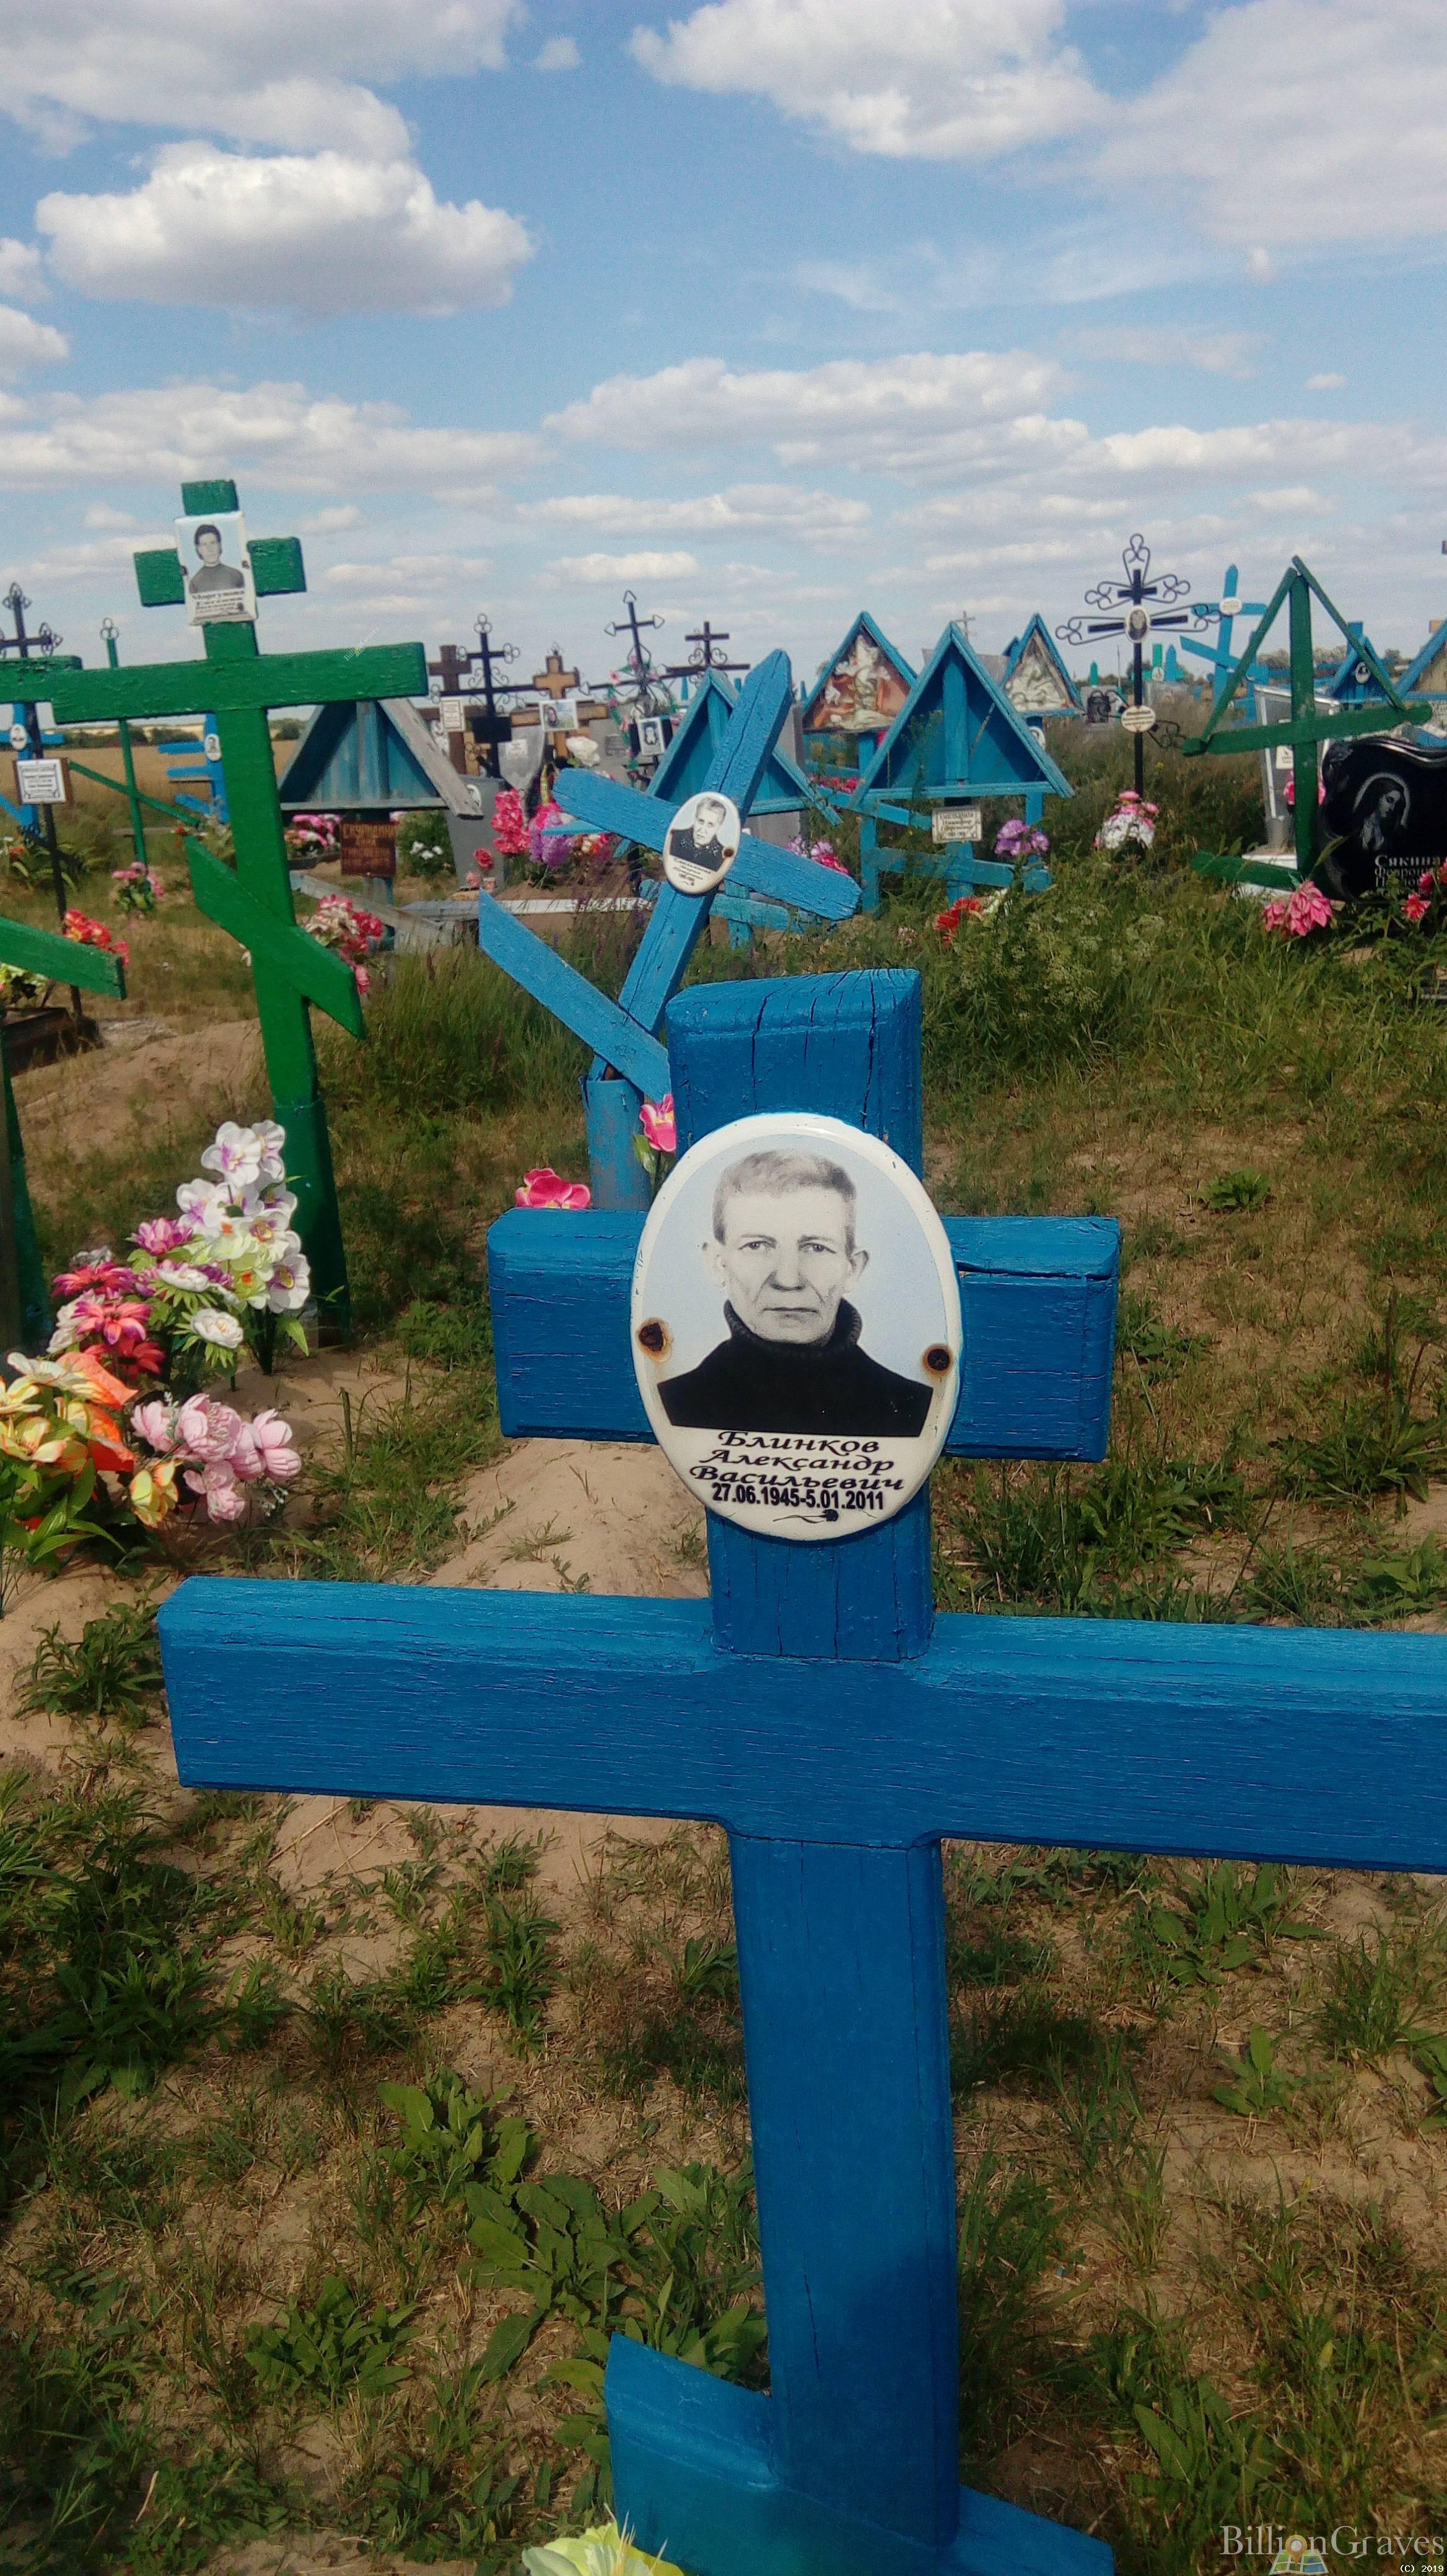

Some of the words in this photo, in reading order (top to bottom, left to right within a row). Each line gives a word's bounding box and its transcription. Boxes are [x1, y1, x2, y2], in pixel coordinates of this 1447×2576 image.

[718, 1431, 880, 1456] Блинков
[699, 1449, 894, 1476] Александр
[689, 1466, 904, 1490] Васильевич
[712, 1482, 883, 1510] 27.06.1945-5.01.2011
